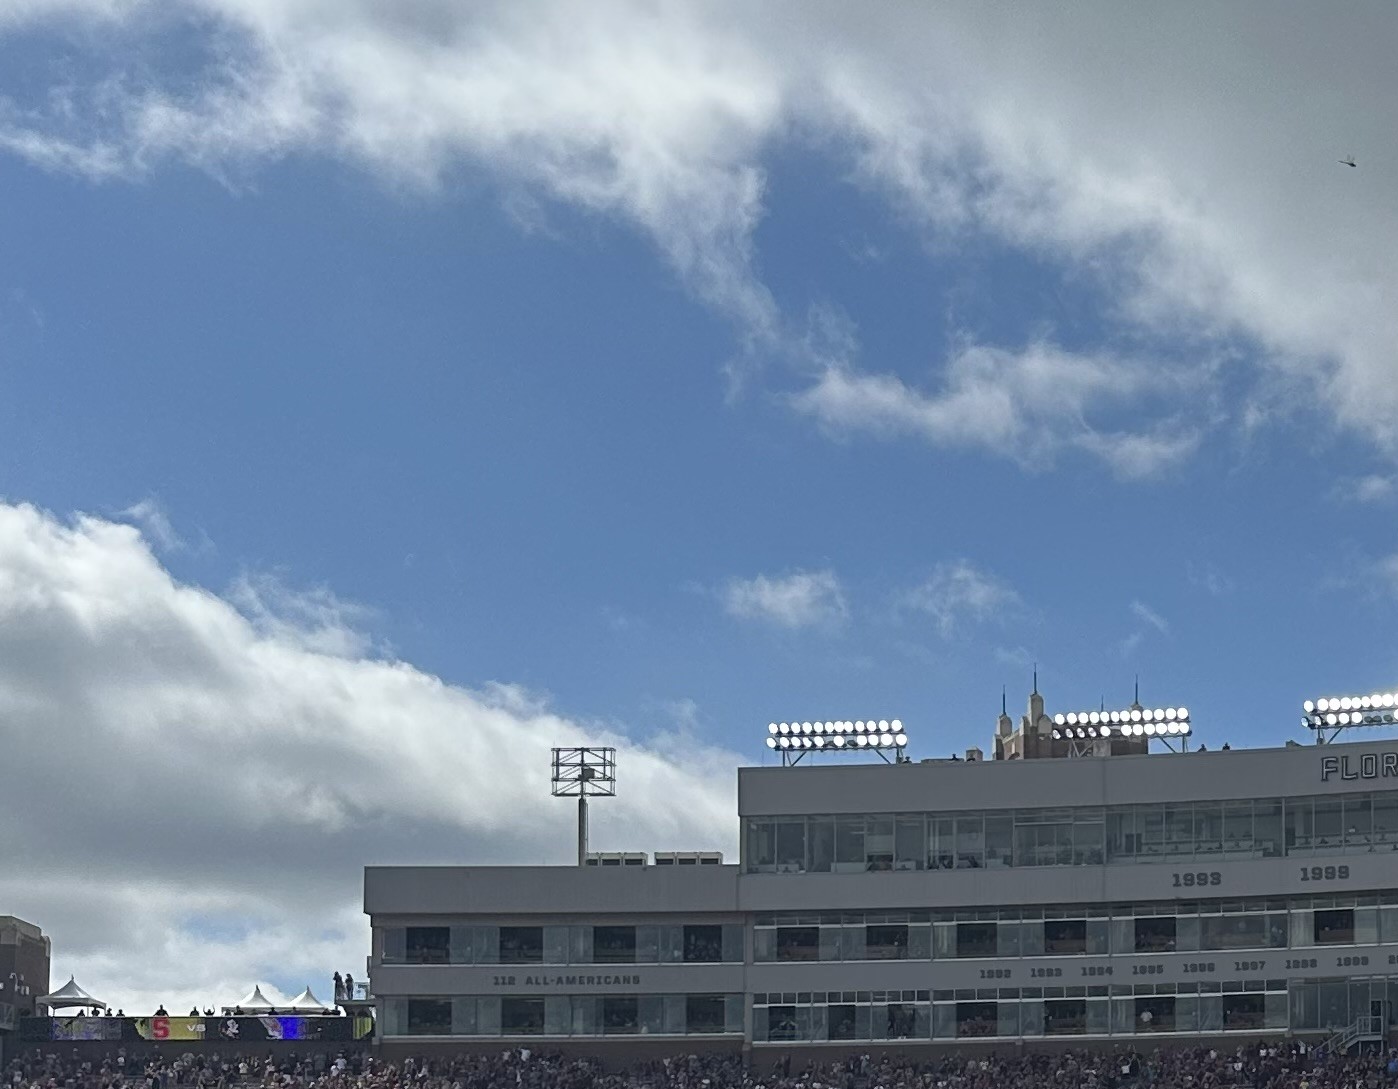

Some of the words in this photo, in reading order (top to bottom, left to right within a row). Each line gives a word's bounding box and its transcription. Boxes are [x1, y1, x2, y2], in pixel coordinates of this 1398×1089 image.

[1173, 872, 1221, 887] 1993
[1301, 866, 1349, 881] 1999
[525, 975, 640, 986] ALL-AMERICANS
